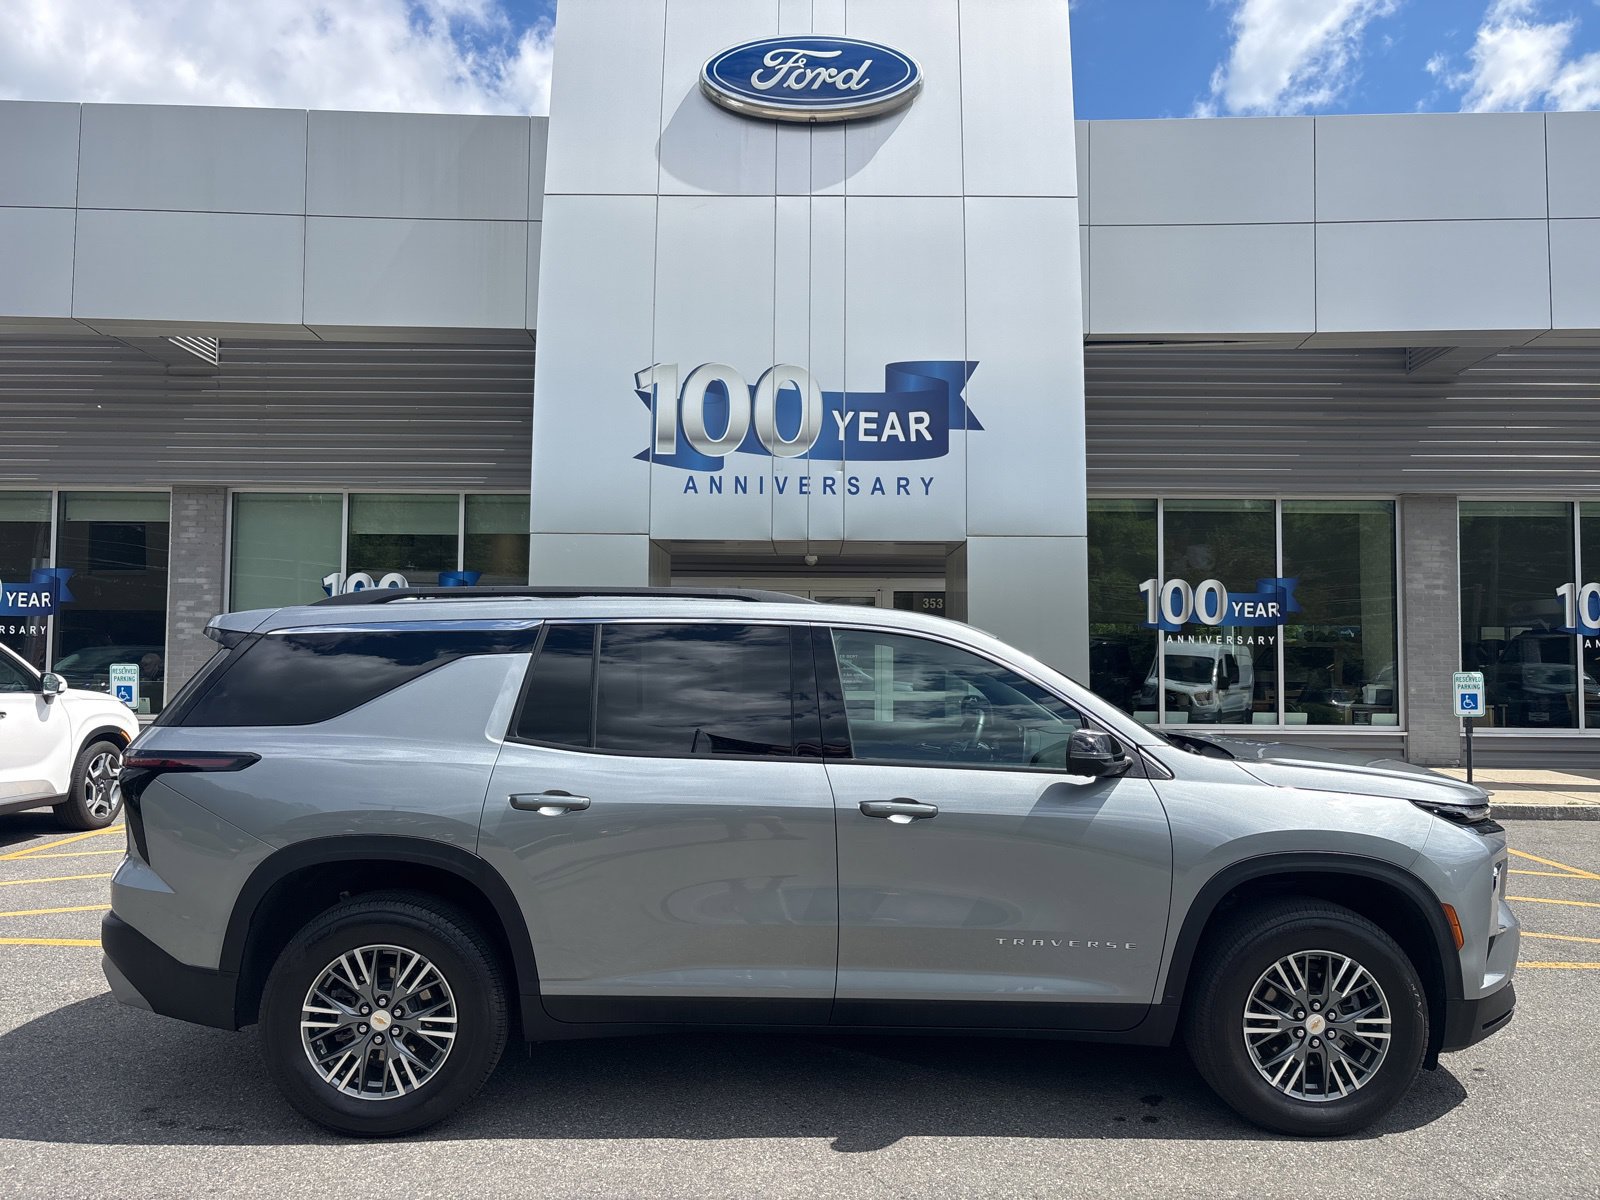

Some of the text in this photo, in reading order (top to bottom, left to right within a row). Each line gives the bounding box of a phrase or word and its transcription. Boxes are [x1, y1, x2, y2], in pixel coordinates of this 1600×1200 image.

[750, 48, 873, 91] Ford
[634, 362, 934, 459] 100 YEAR
[683, 475, 935, 496] ANNIVERSARY
[6, 591, 52, 608] YEAR
[922, 598, 944, 609] 353
[1138, 578, 1281, 626] 100 YEAR
[1166, 634, 1276, 645] ANNIVERSARY
[112, 667, 137, 675] RESERVED
[995, 937, 1137, 950] TRAVERSE
